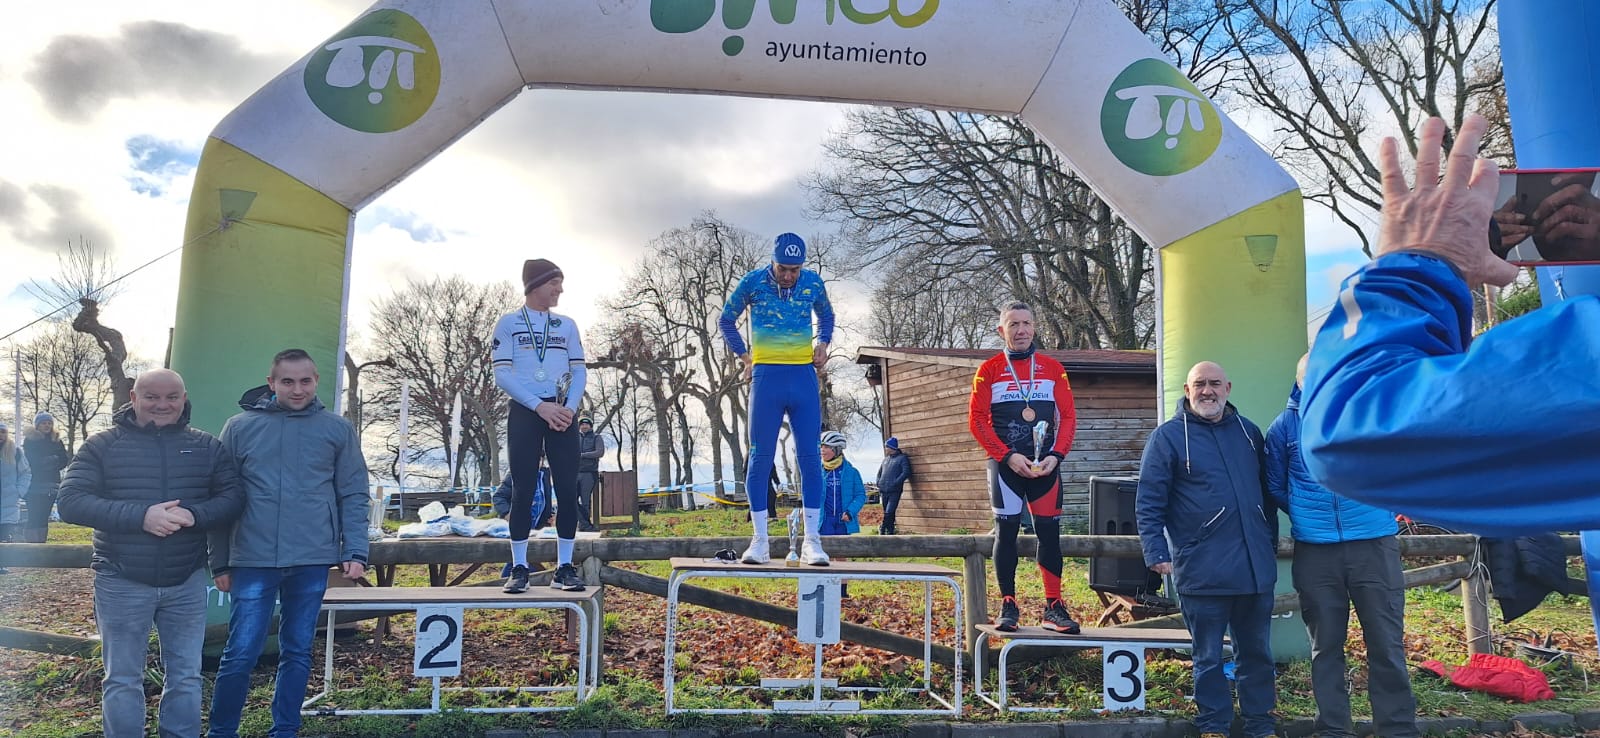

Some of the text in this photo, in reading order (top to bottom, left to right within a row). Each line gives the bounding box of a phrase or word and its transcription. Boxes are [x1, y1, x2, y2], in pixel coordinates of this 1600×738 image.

[765, 40, 927, 67] ayuntamiento
[802, 585, 824, 638] 1
[419, 615, 457, 669] 2
[1107, 650, 1142, 702] 3
